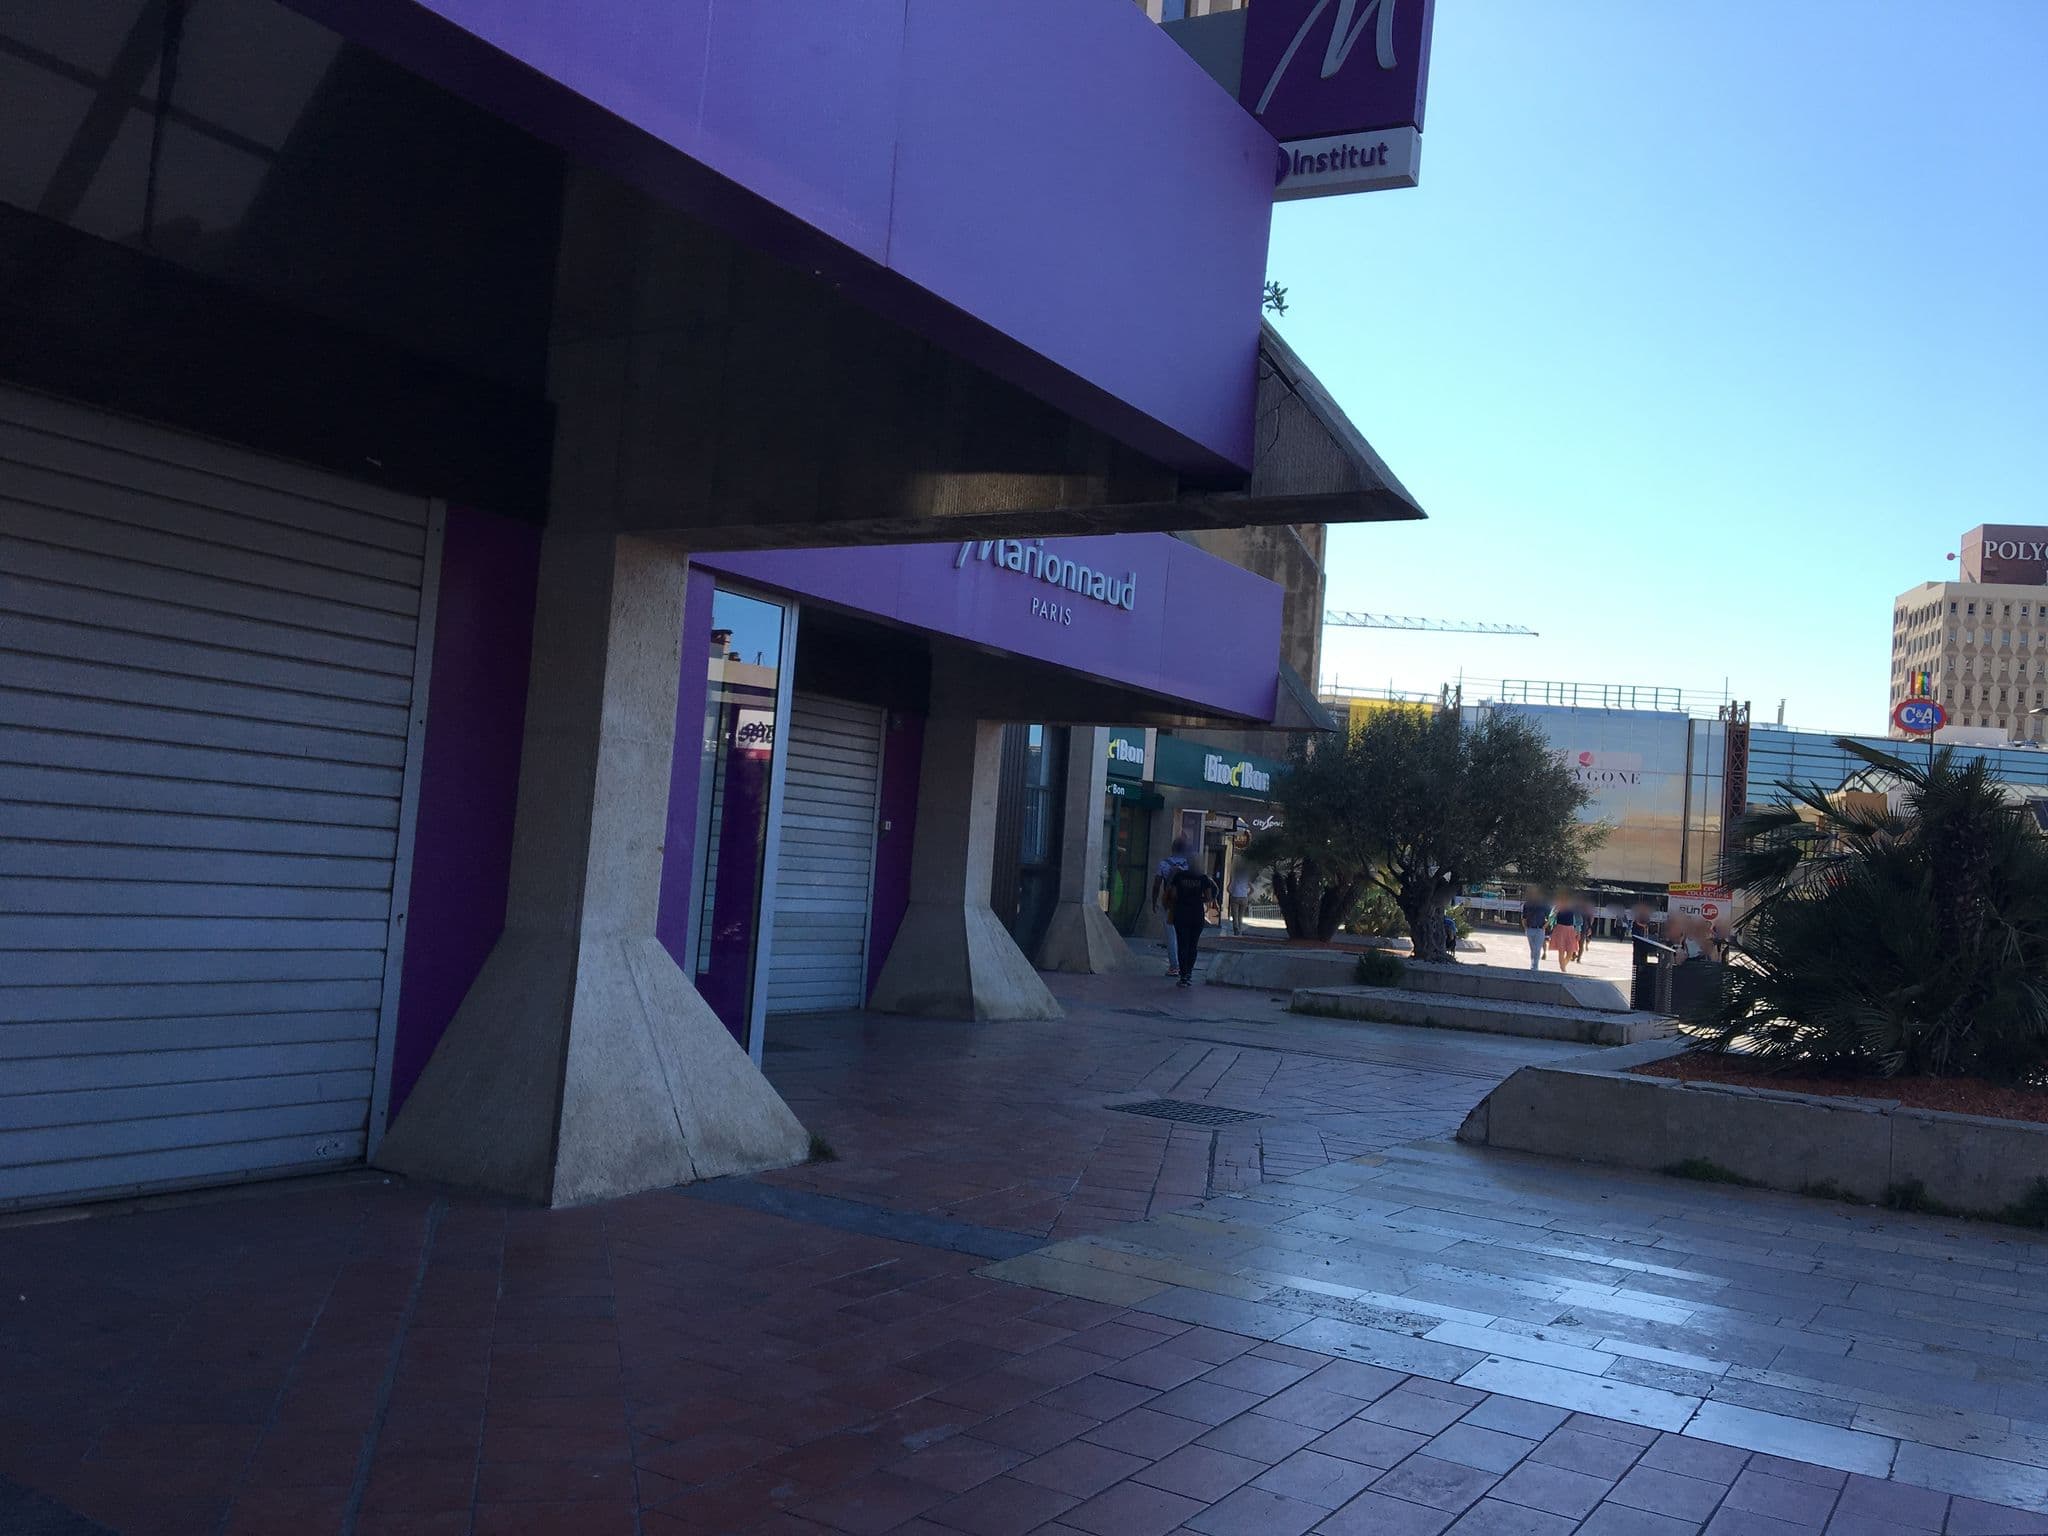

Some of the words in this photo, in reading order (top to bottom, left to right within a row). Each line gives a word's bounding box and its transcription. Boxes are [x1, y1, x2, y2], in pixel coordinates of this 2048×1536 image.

[1293, 141, 1389, 176] Institut
[1984, 540, 2048, 561] POLY
[955, 539, 1137, 611] Marionnaud
[1032, 597, 1073, 626] PARIS
[1900, 706, 1938, 724] C&A
[1575, 769, 1640, 784] YGONE
